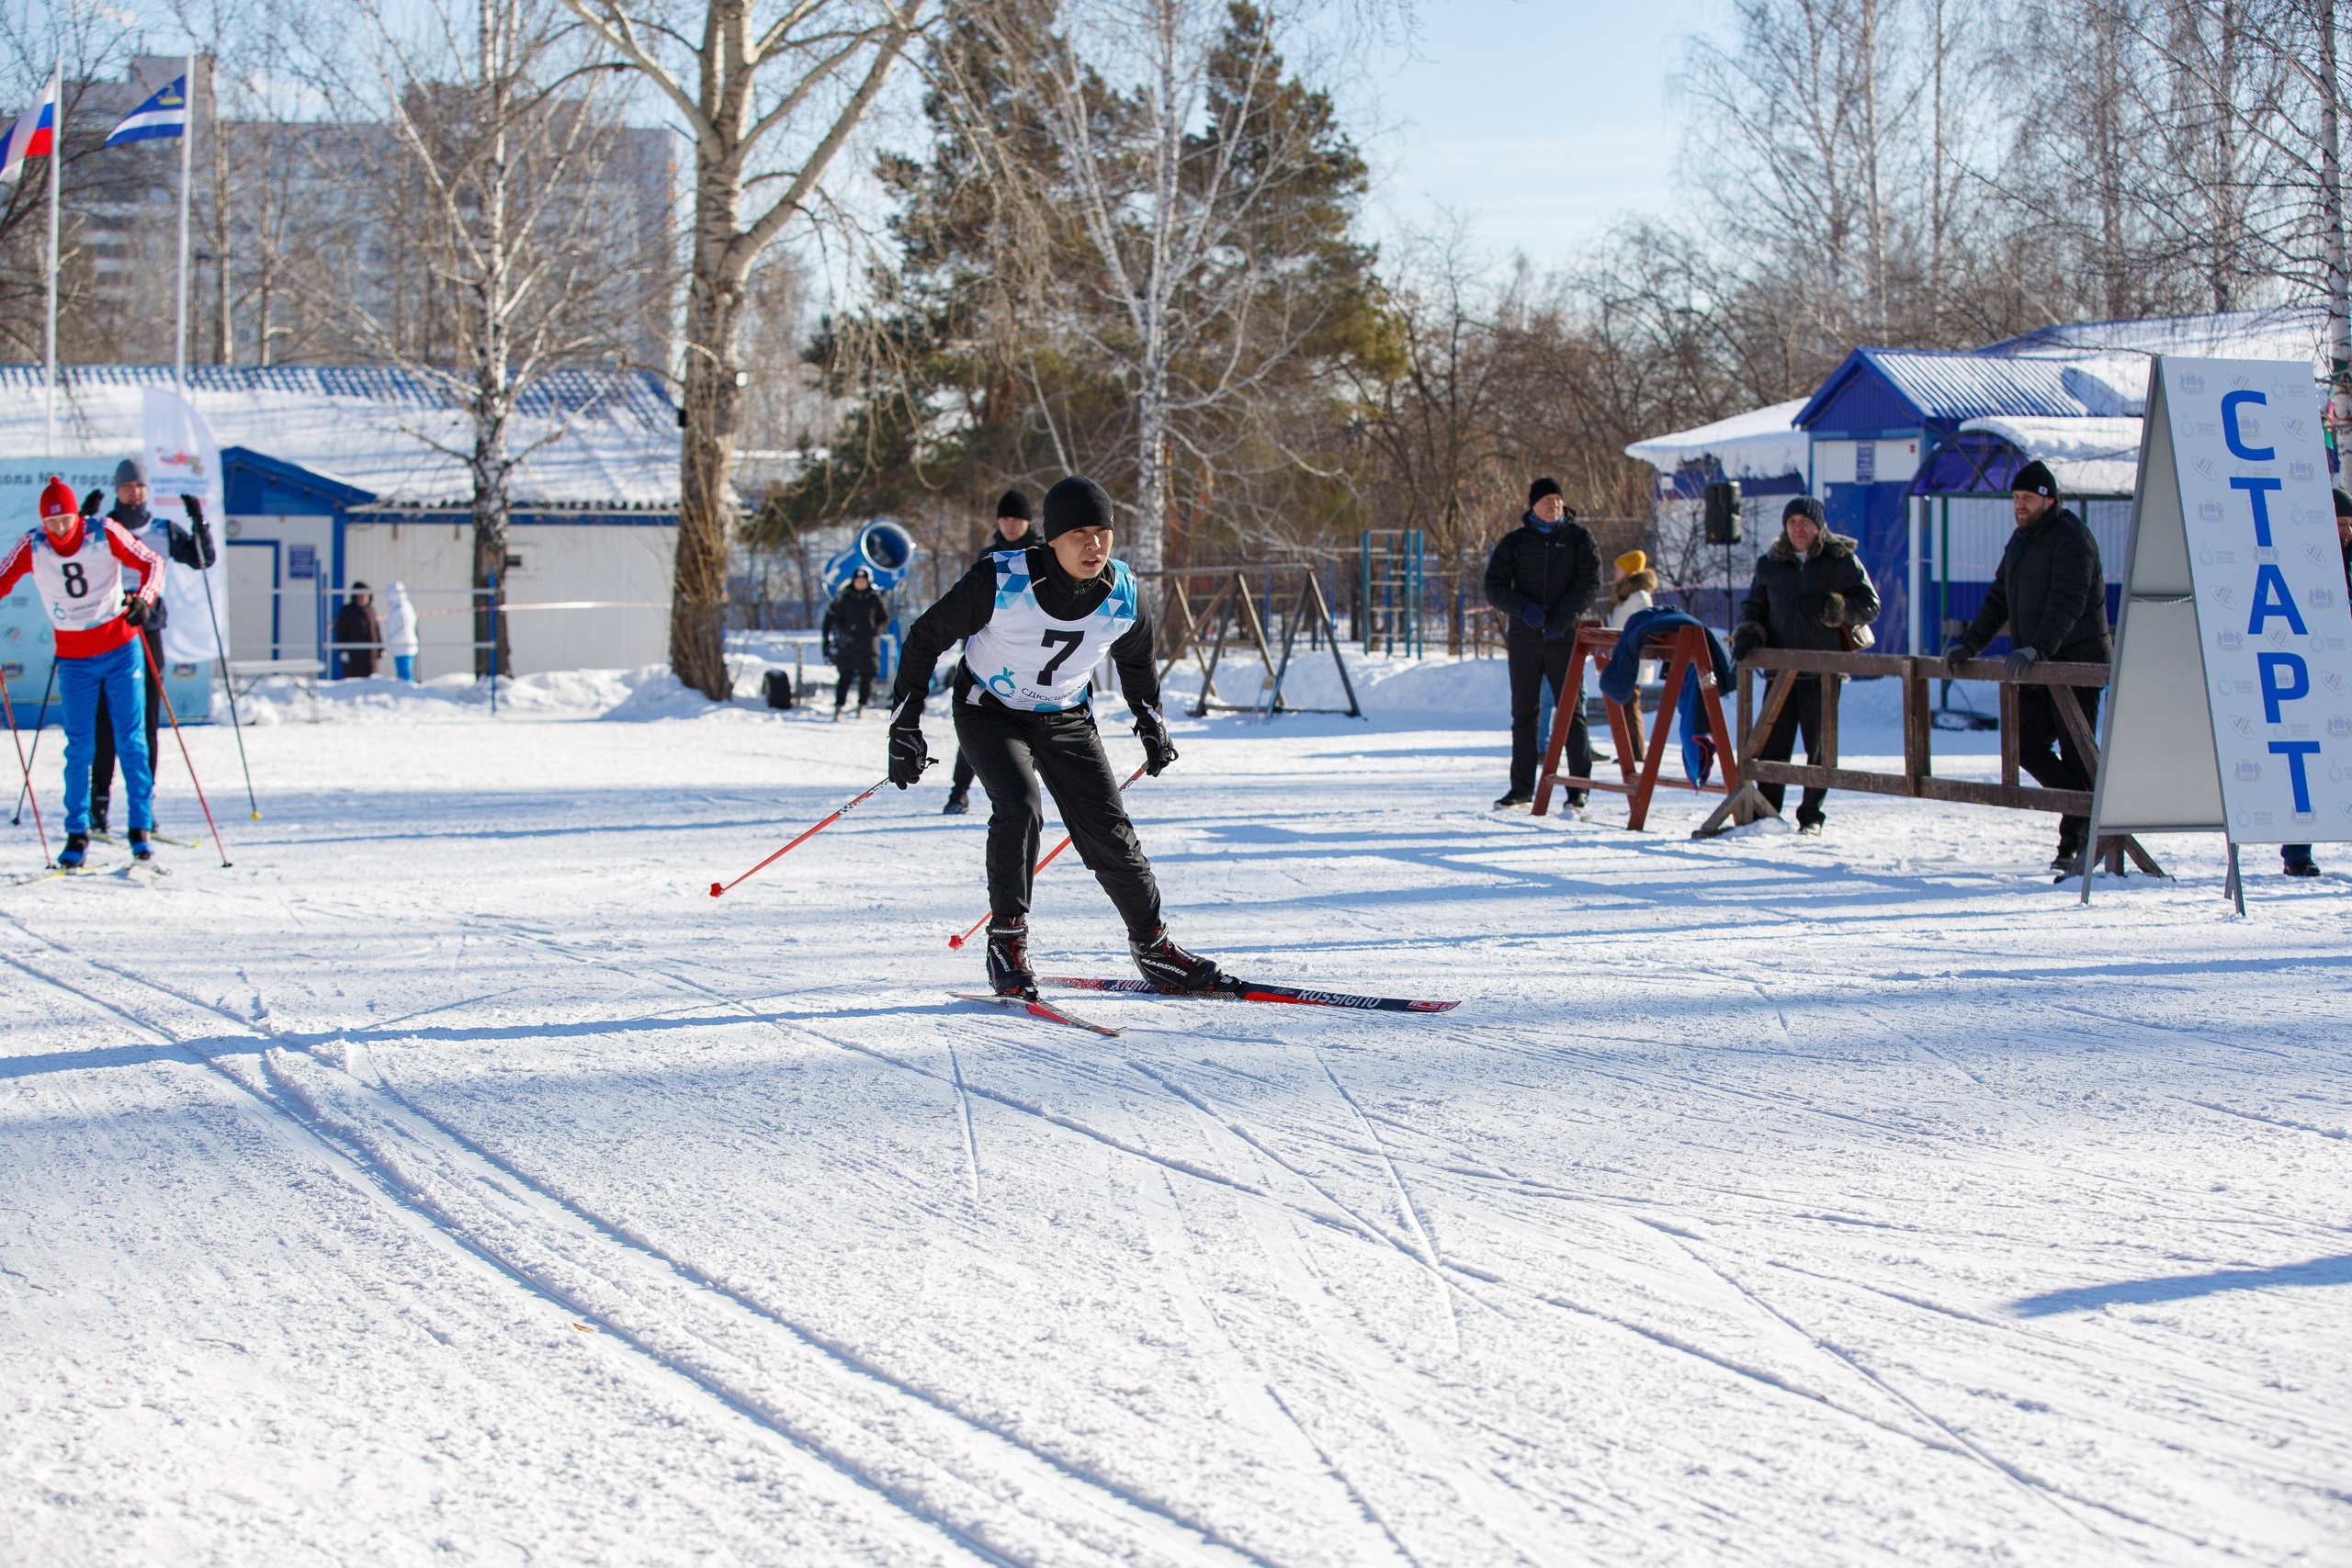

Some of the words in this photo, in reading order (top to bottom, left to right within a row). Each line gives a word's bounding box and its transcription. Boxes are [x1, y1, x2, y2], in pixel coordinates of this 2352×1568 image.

[71, 474, 117, 488] горо
[62, 562, 88, 598] 8
[2221, 390, 2322, 813] СТАРТ
[1036, 628, 1085, 686] 7
[1140, 958, 1188, 976] MADSHUS
